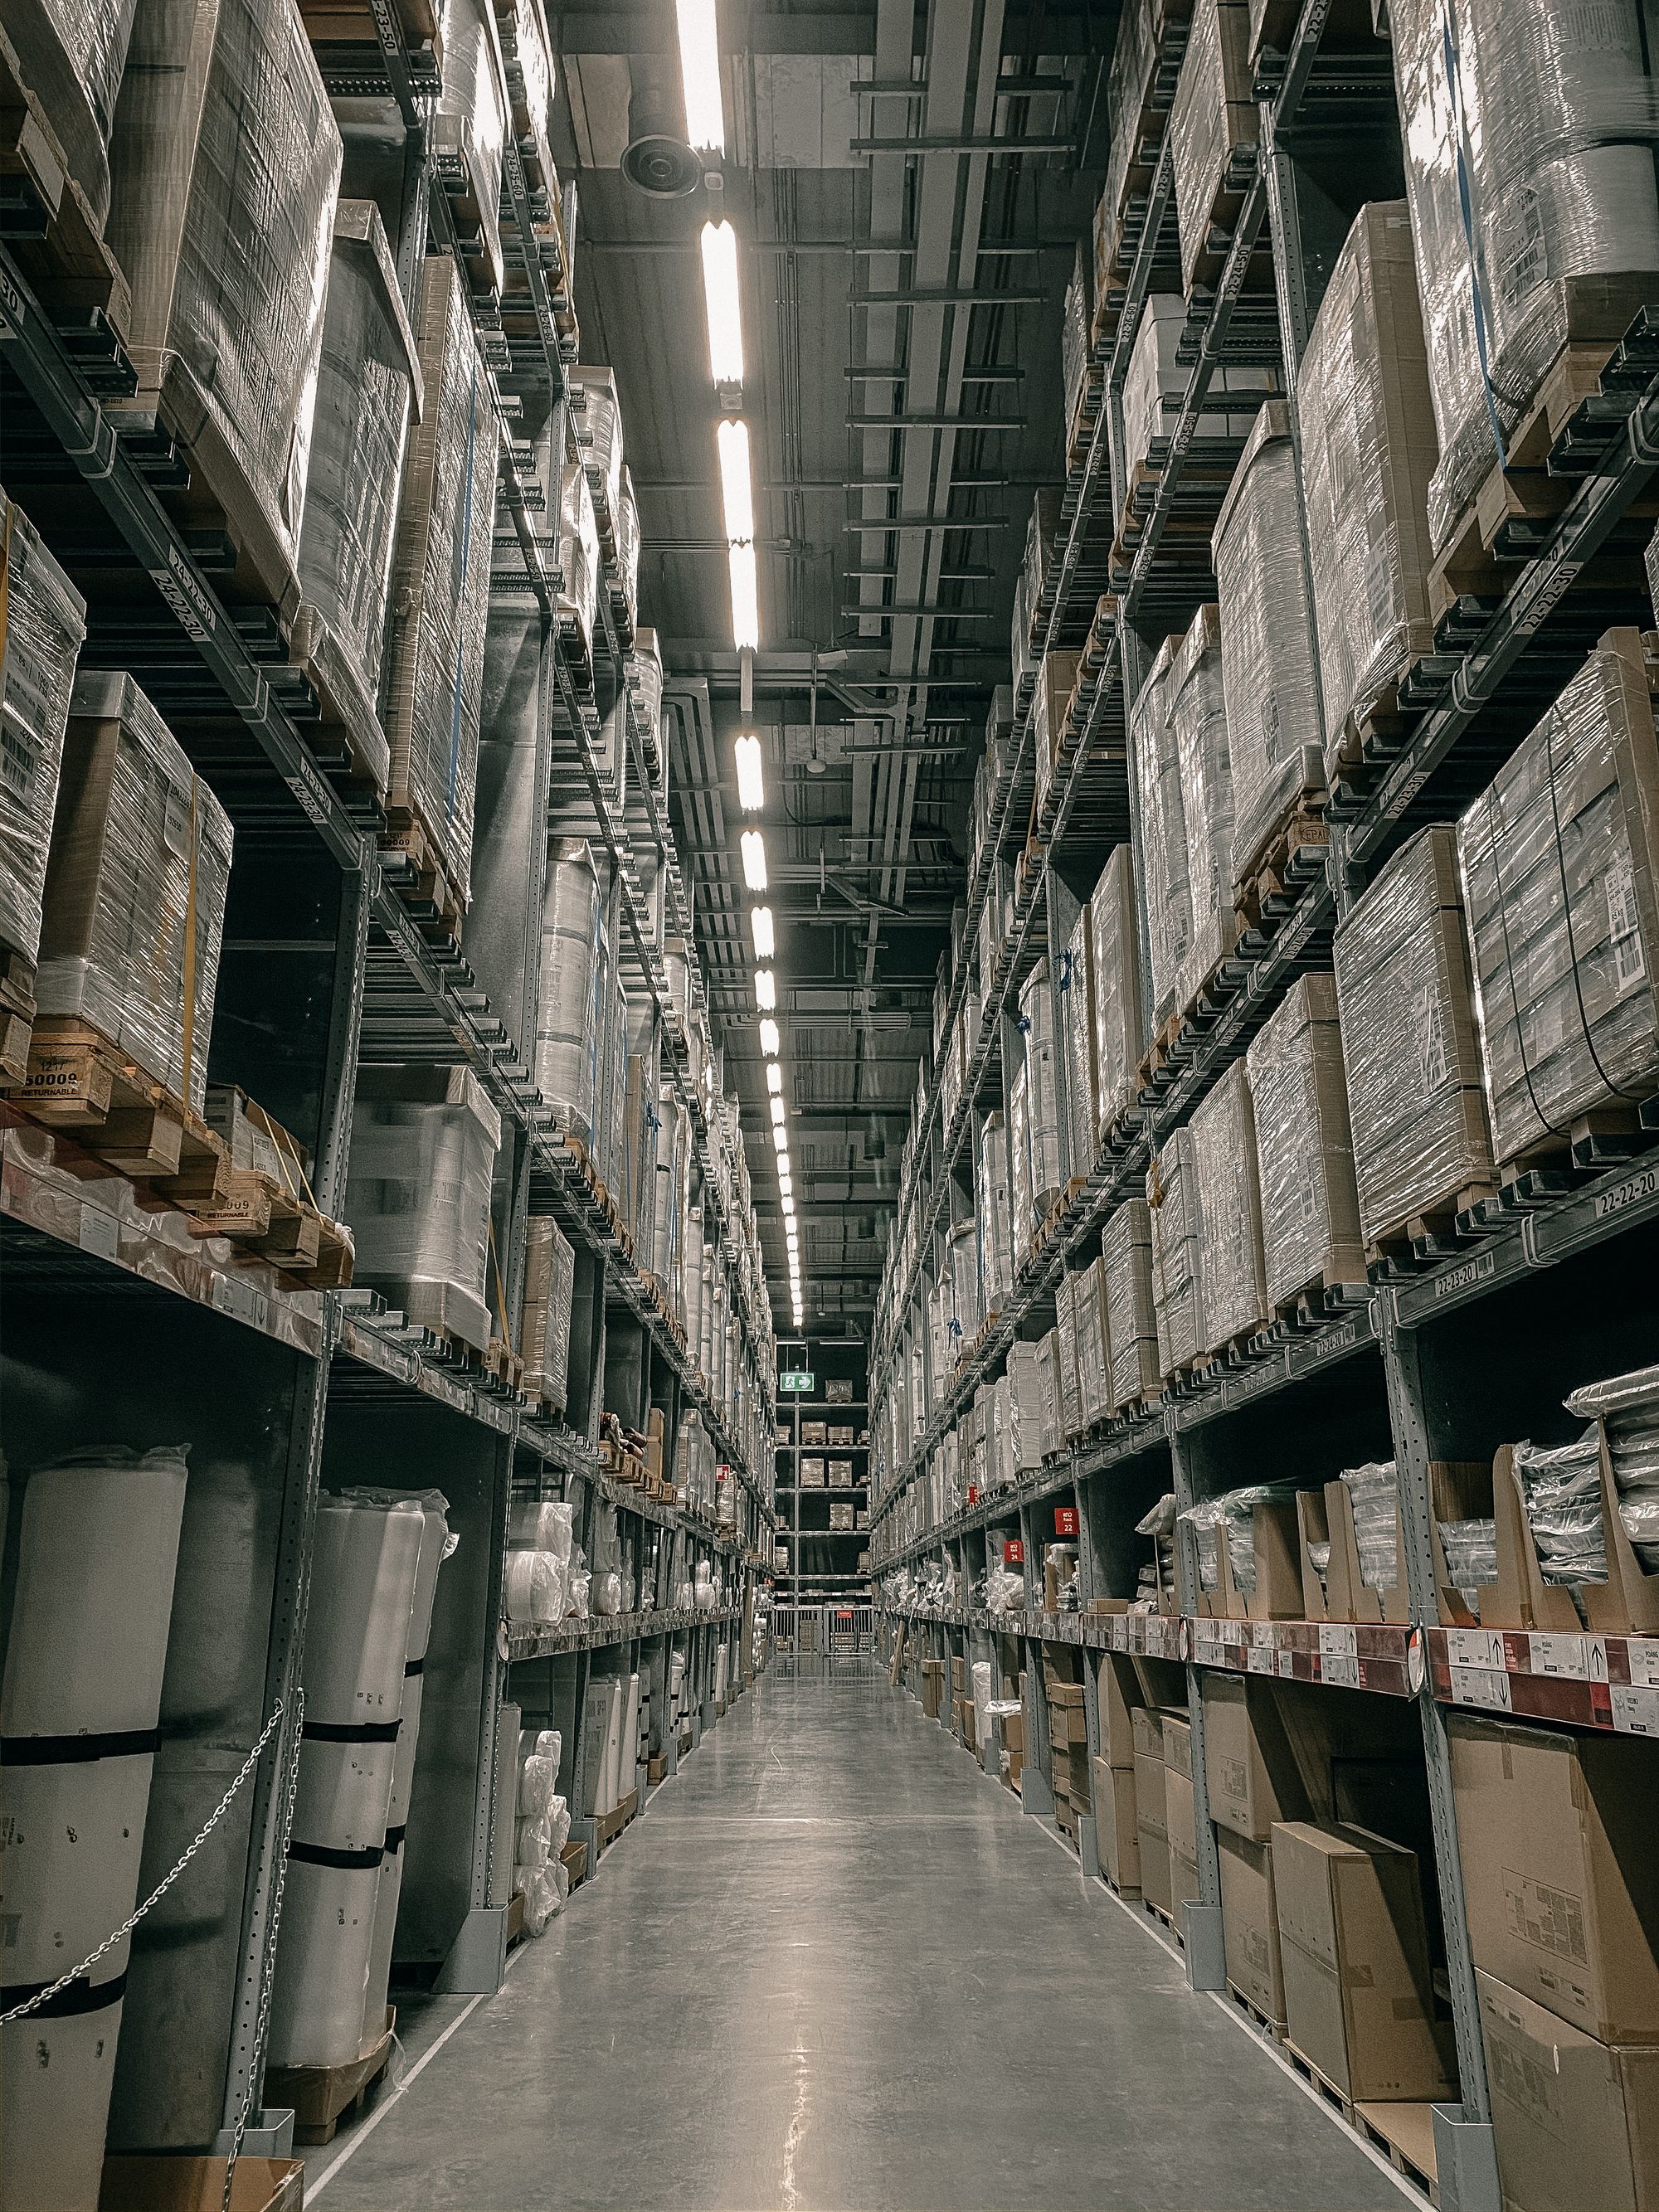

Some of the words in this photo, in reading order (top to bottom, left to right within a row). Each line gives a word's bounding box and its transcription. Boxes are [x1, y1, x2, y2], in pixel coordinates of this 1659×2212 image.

[373, 0, 396, 48] -23-50
[506, 155, 523, 197] 24-25-60
[1227, 249, 1249, 295] 22-24-50
[539, 309, 553, 342] 24-26-60
[1123, 305, 1136, 339] 22-26-60
[1178, 416, 1195, 451] 22-25-50
[1091, 445, 1102, 473] 22-27-60
[1138, 548, 1154, 577] 22-26-50
[153, 576, 205, 636] 24-22-30
[174, 553, 212, 623] 24-22-30
[1520, 568, 1577, 629] 22-22-30
[287, 781, 324, 820] 24-23-30
[1388, 775, 1427, 814] 22-23-30
[388, 933, 414, 960] 24-24-30
[1287, 929, 1313, 956] 22-24-30
[25, 1073, 77, 1086] 50009
[1602, 1172, 1655, 1213] 22-22-20
[1439, 1265, 1472, 1295] 22-23-20
